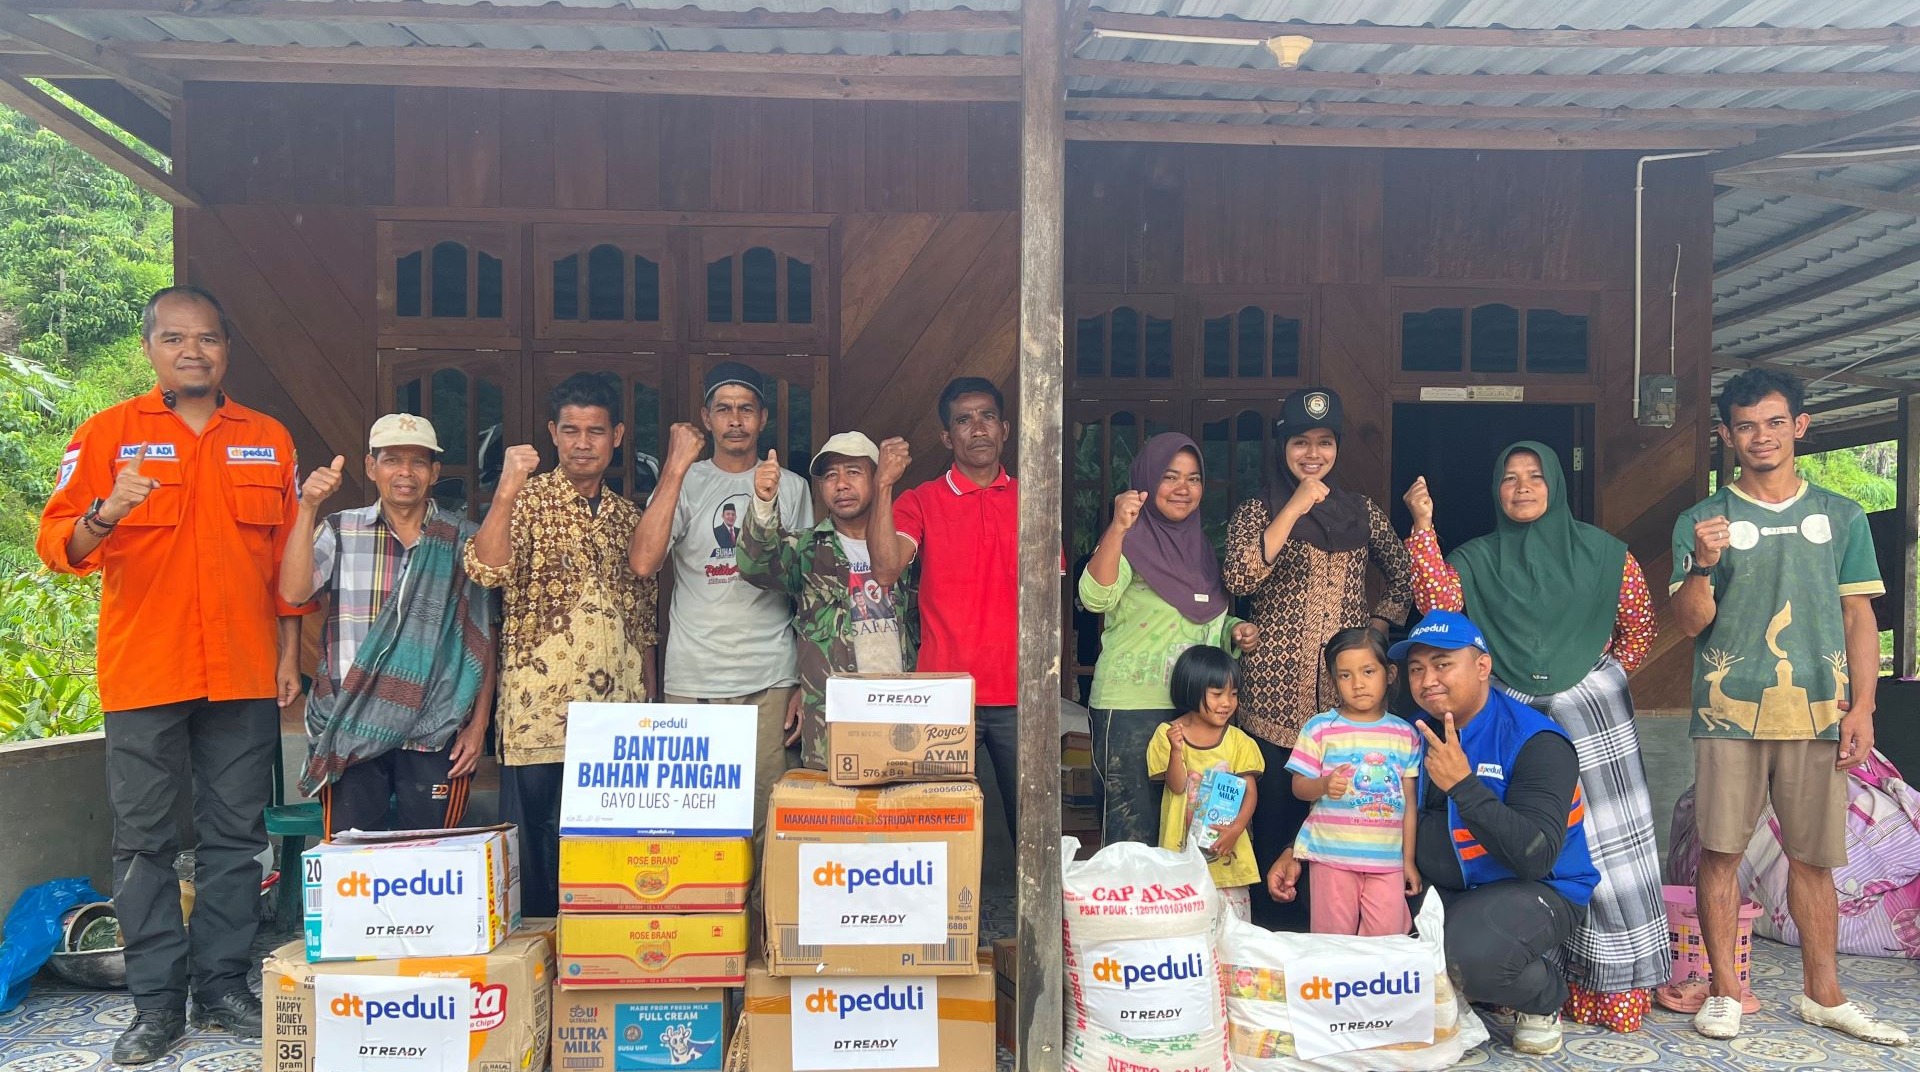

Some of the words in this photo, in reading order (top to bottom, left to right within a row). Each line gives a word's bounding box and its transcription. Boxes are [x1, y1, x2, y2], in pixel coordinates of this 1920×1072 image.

[156, 445, 172, 455] ADI
[867, 693, 886, 703] DT
[886, 695, 932, 704] READY
[638, 717, 688, 731] dtpeduli
[926, 726, 966, 742] Royco
[613, 735, 710, 762] BANTUAN
[924, 750, 969, 761] AYAM
[842, 756, 853, 771] 8
[577, 762, 650, 789] BAHAN
[656, 763, 742, 790] PANGAN
[863, 769, 880, 778] 576
[1217, 783, 1239, 796] ULTRA
[601, 792, 635, 809] GAYO
[639, 793, 670, 809] LUES
[682, 793, 716, 809] ACEH
[1219, 791, 1236, 802] MILK
[784, 813, 828, 824] MAKANAN
[830, 814, 864, 825] RINGAN
[918, 814, 942, 824] RASA
[944, 813, 966, 824] KEJU
[627, 856, 649, 865] ROSE
[651, 856, 678, 865] BRAND
[306, 858, 322, 882] 20
[813, 860, 933, 893] dtpeduli
[337, 869, 463, 904] dtpeduli
[1092, 885, 1134, 901] CAP
[1140, 883, 1198, 903] AYAM
[1079, 905, 1100, 916] PSAT
[841, 915, 859, 924] DT
[860, 914, 907, 924] READY
[366, 925, 385, 936] DT
[387, 924, 435, 936] READY
[947, 922, 968, 930] 6888
[629, 931, 650, 940] ROSE
[651, 931, 677, 940] BRAND
[901, 953, 915, 966] PI
[1092, 953, 1203, 990] dtpeduli
[1300, 971, 1420, 1005] dtpeduli
[276, 1001, 302, 1012] HAPPY
[805, 985, 924, 1019] dtpeduli
[330, 993, 455, 1025] dtpeduli
[1120, 1010, 1138, 1020] DT
[1139, 1008, 1183, 1020] READY
[276, 1013, 303, 1024] HONEY
[638, 1013, 663, 1021] FULL
[664, 1012, 698, 1021] CREAM
[476, 1019, 495, 1028] Chips
[1329, 1022, 1347, 1033] DT
[1348, 1020, 1394, 1030] READY
[276, 1024, 308, 1036] BUTTER
[558, 1027, 608, 1041] ULTRA
[563, 1041, 602, 1054] MILK
[834, 1040, 852, 1050] DT
[853, 1039, 898, 1049] READY
[279, 1044, 303, 1060] 35
[359, 1046, 378, 1056] DT
[379, 1046, 427, 1057] READY
[279, 1062, 303, 1070] gram
